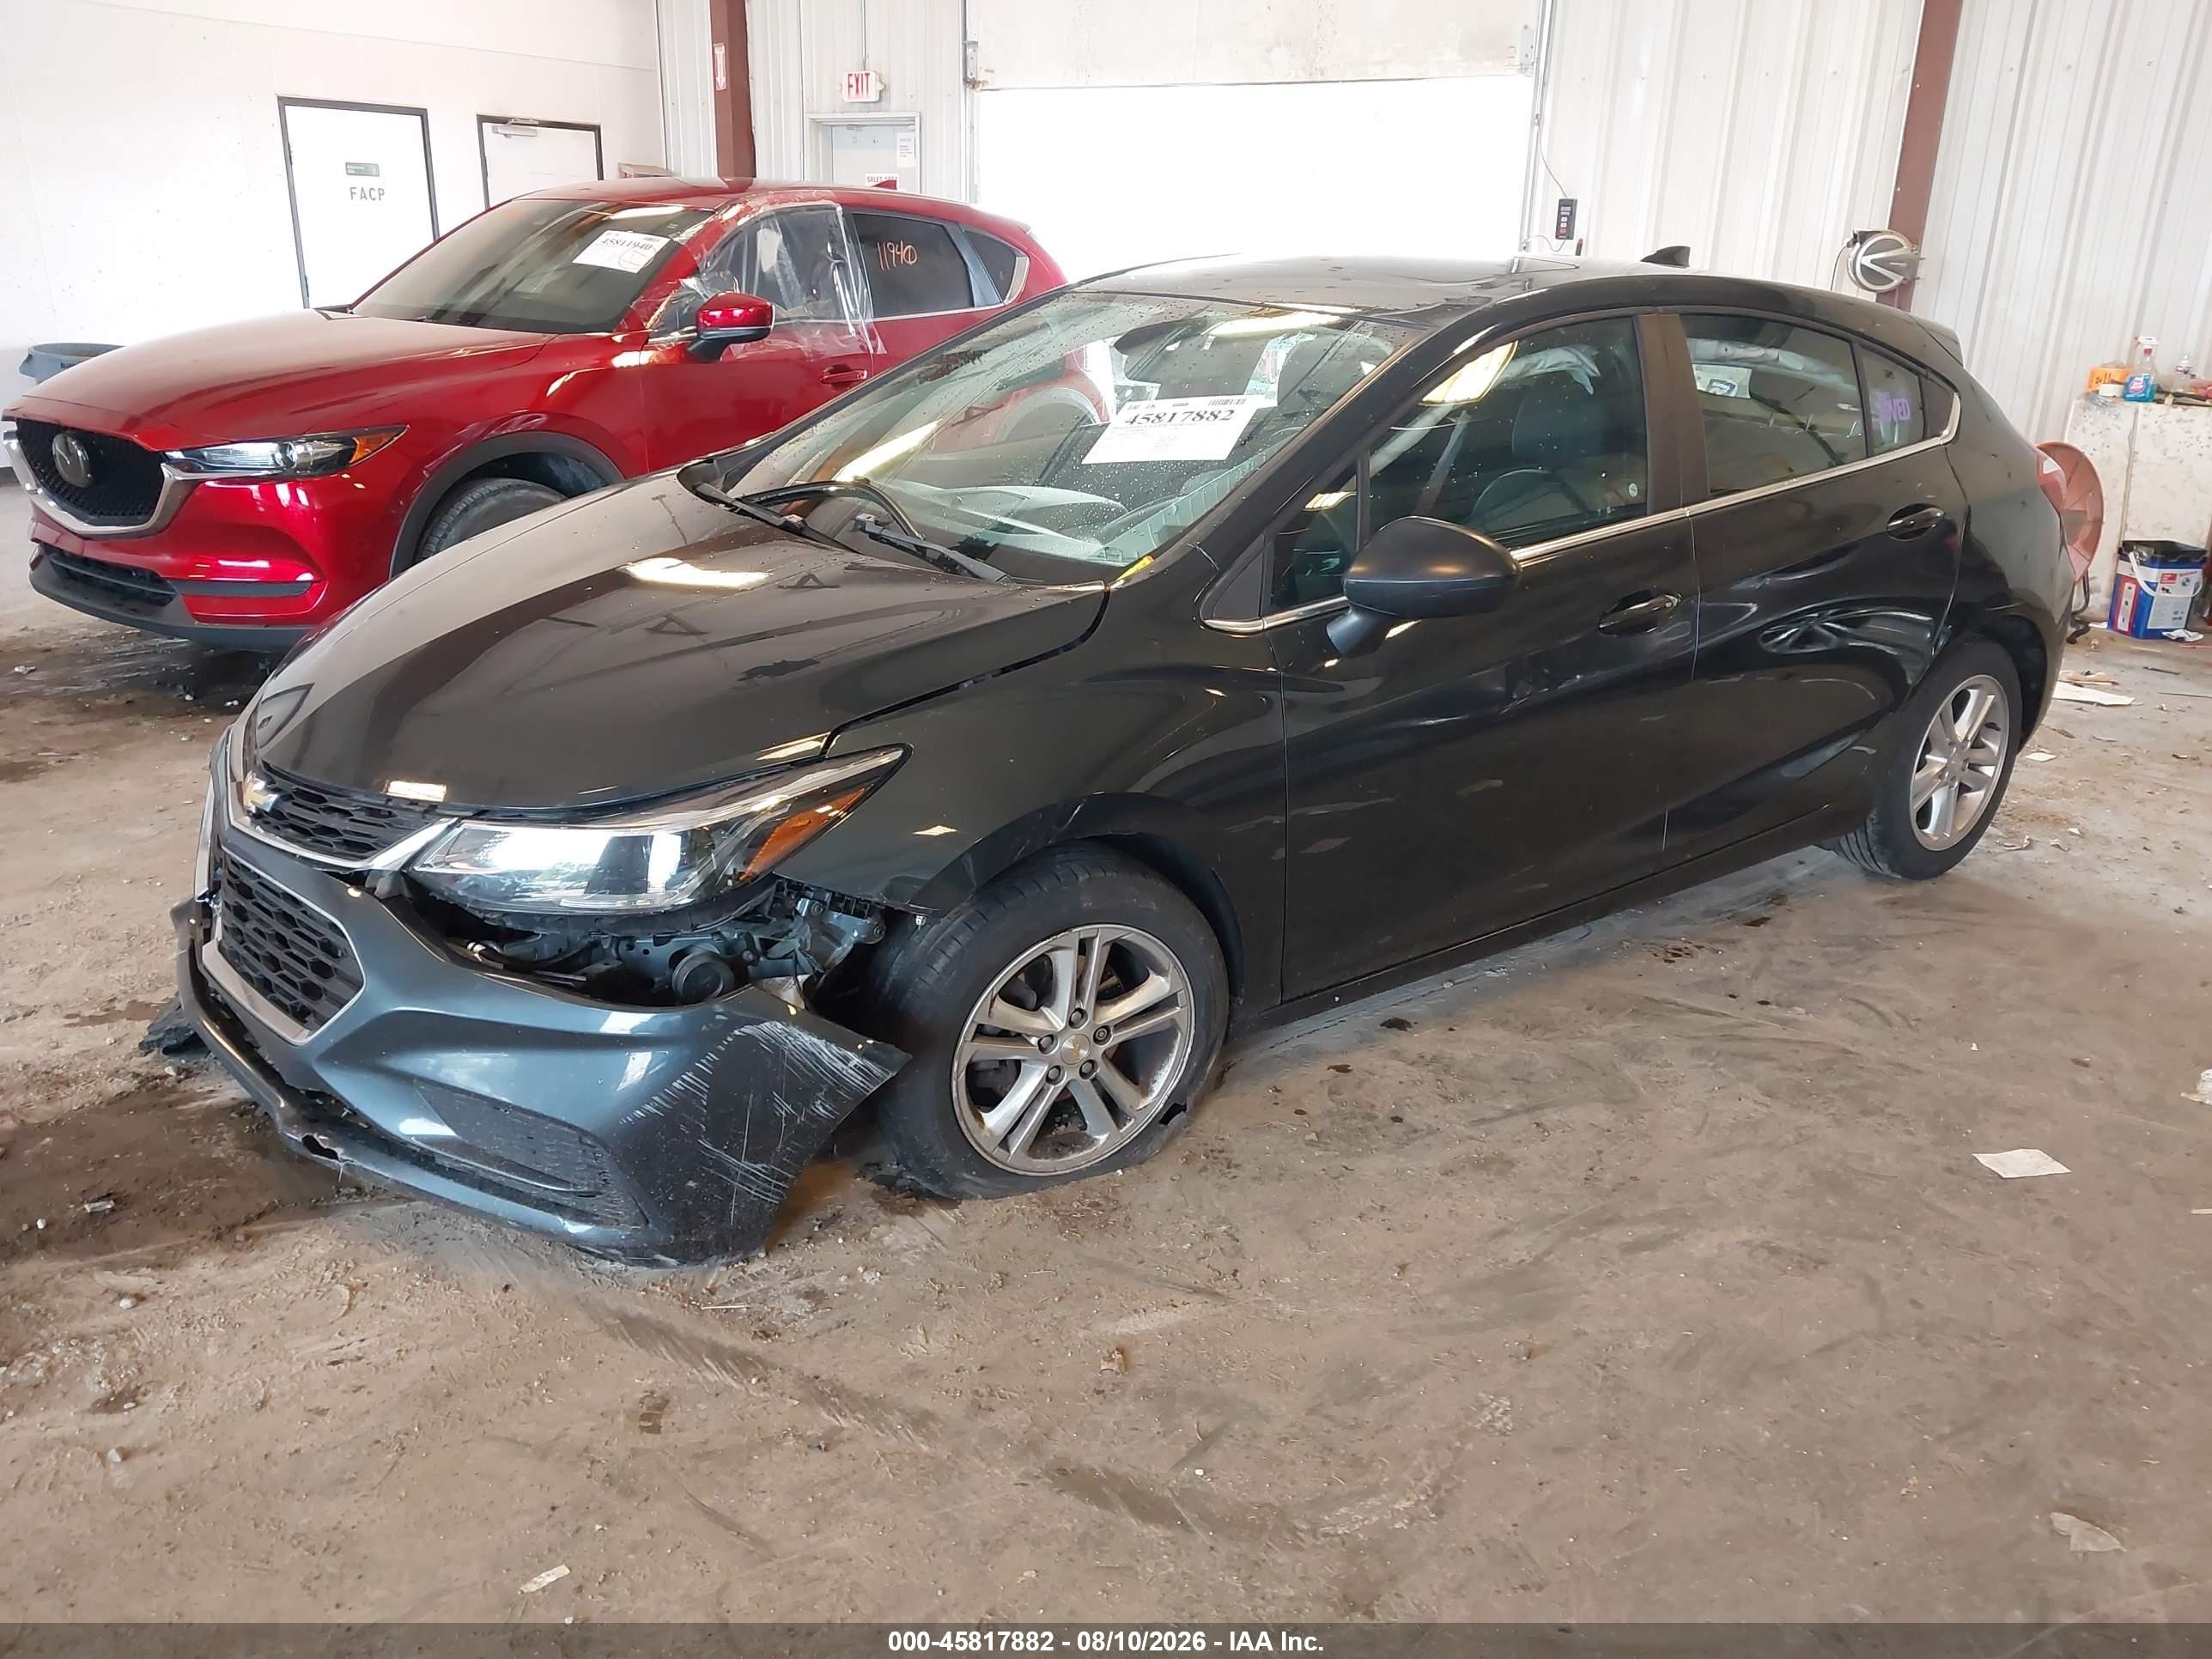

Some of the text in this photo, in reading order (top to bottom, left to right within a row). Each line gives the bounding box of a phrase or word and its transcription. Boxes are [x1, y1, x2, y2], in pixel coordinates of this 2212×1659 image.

[848, 72, 871, 97] EXIT
[349, 186, 386, 201] FACP
[877, 240, 918, 271] 11940
[1125, 409, 1235, 426] 45817882
